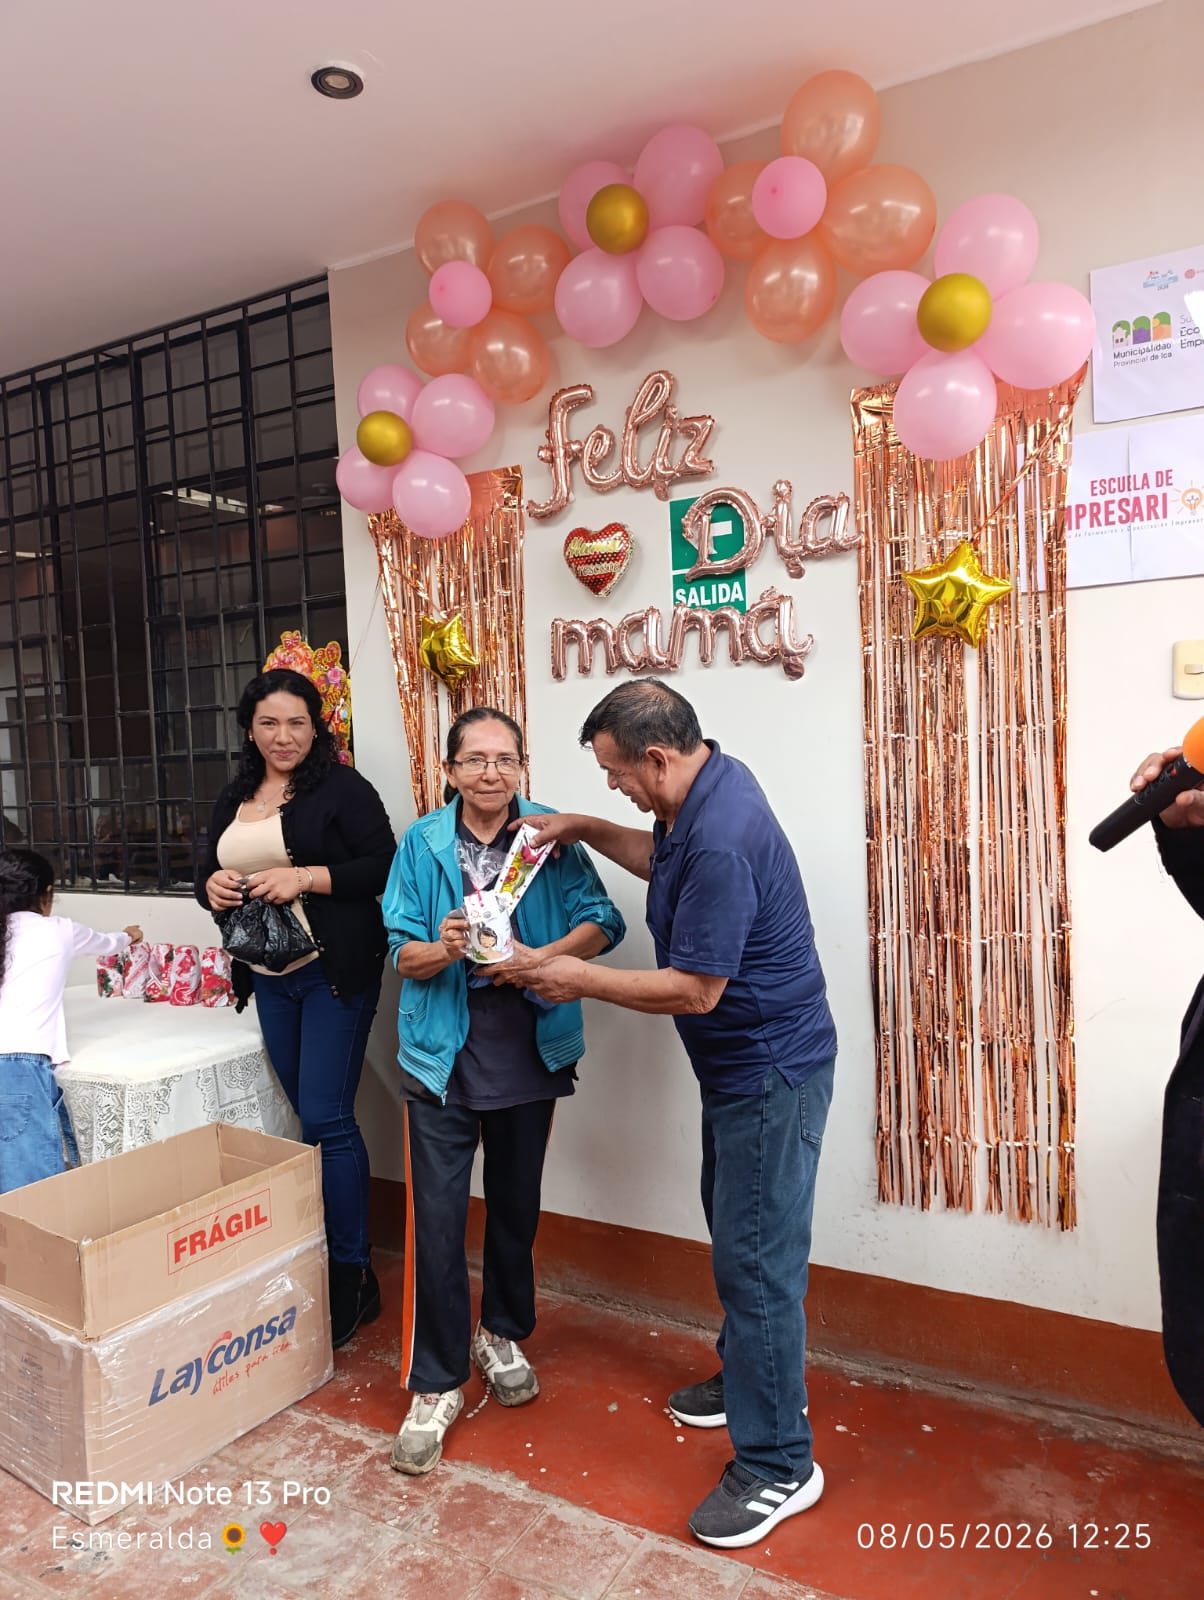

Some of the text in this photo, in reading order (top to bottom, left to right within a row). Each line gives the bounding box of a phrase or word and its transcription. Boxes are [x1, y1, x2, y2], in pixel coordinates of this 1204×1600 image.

[1090, 469, 1174, 497] ESCUELA DE
[675, 581, 745, 608] SALIDA
[174, 1204, 268, 1265] FRÁGIL
